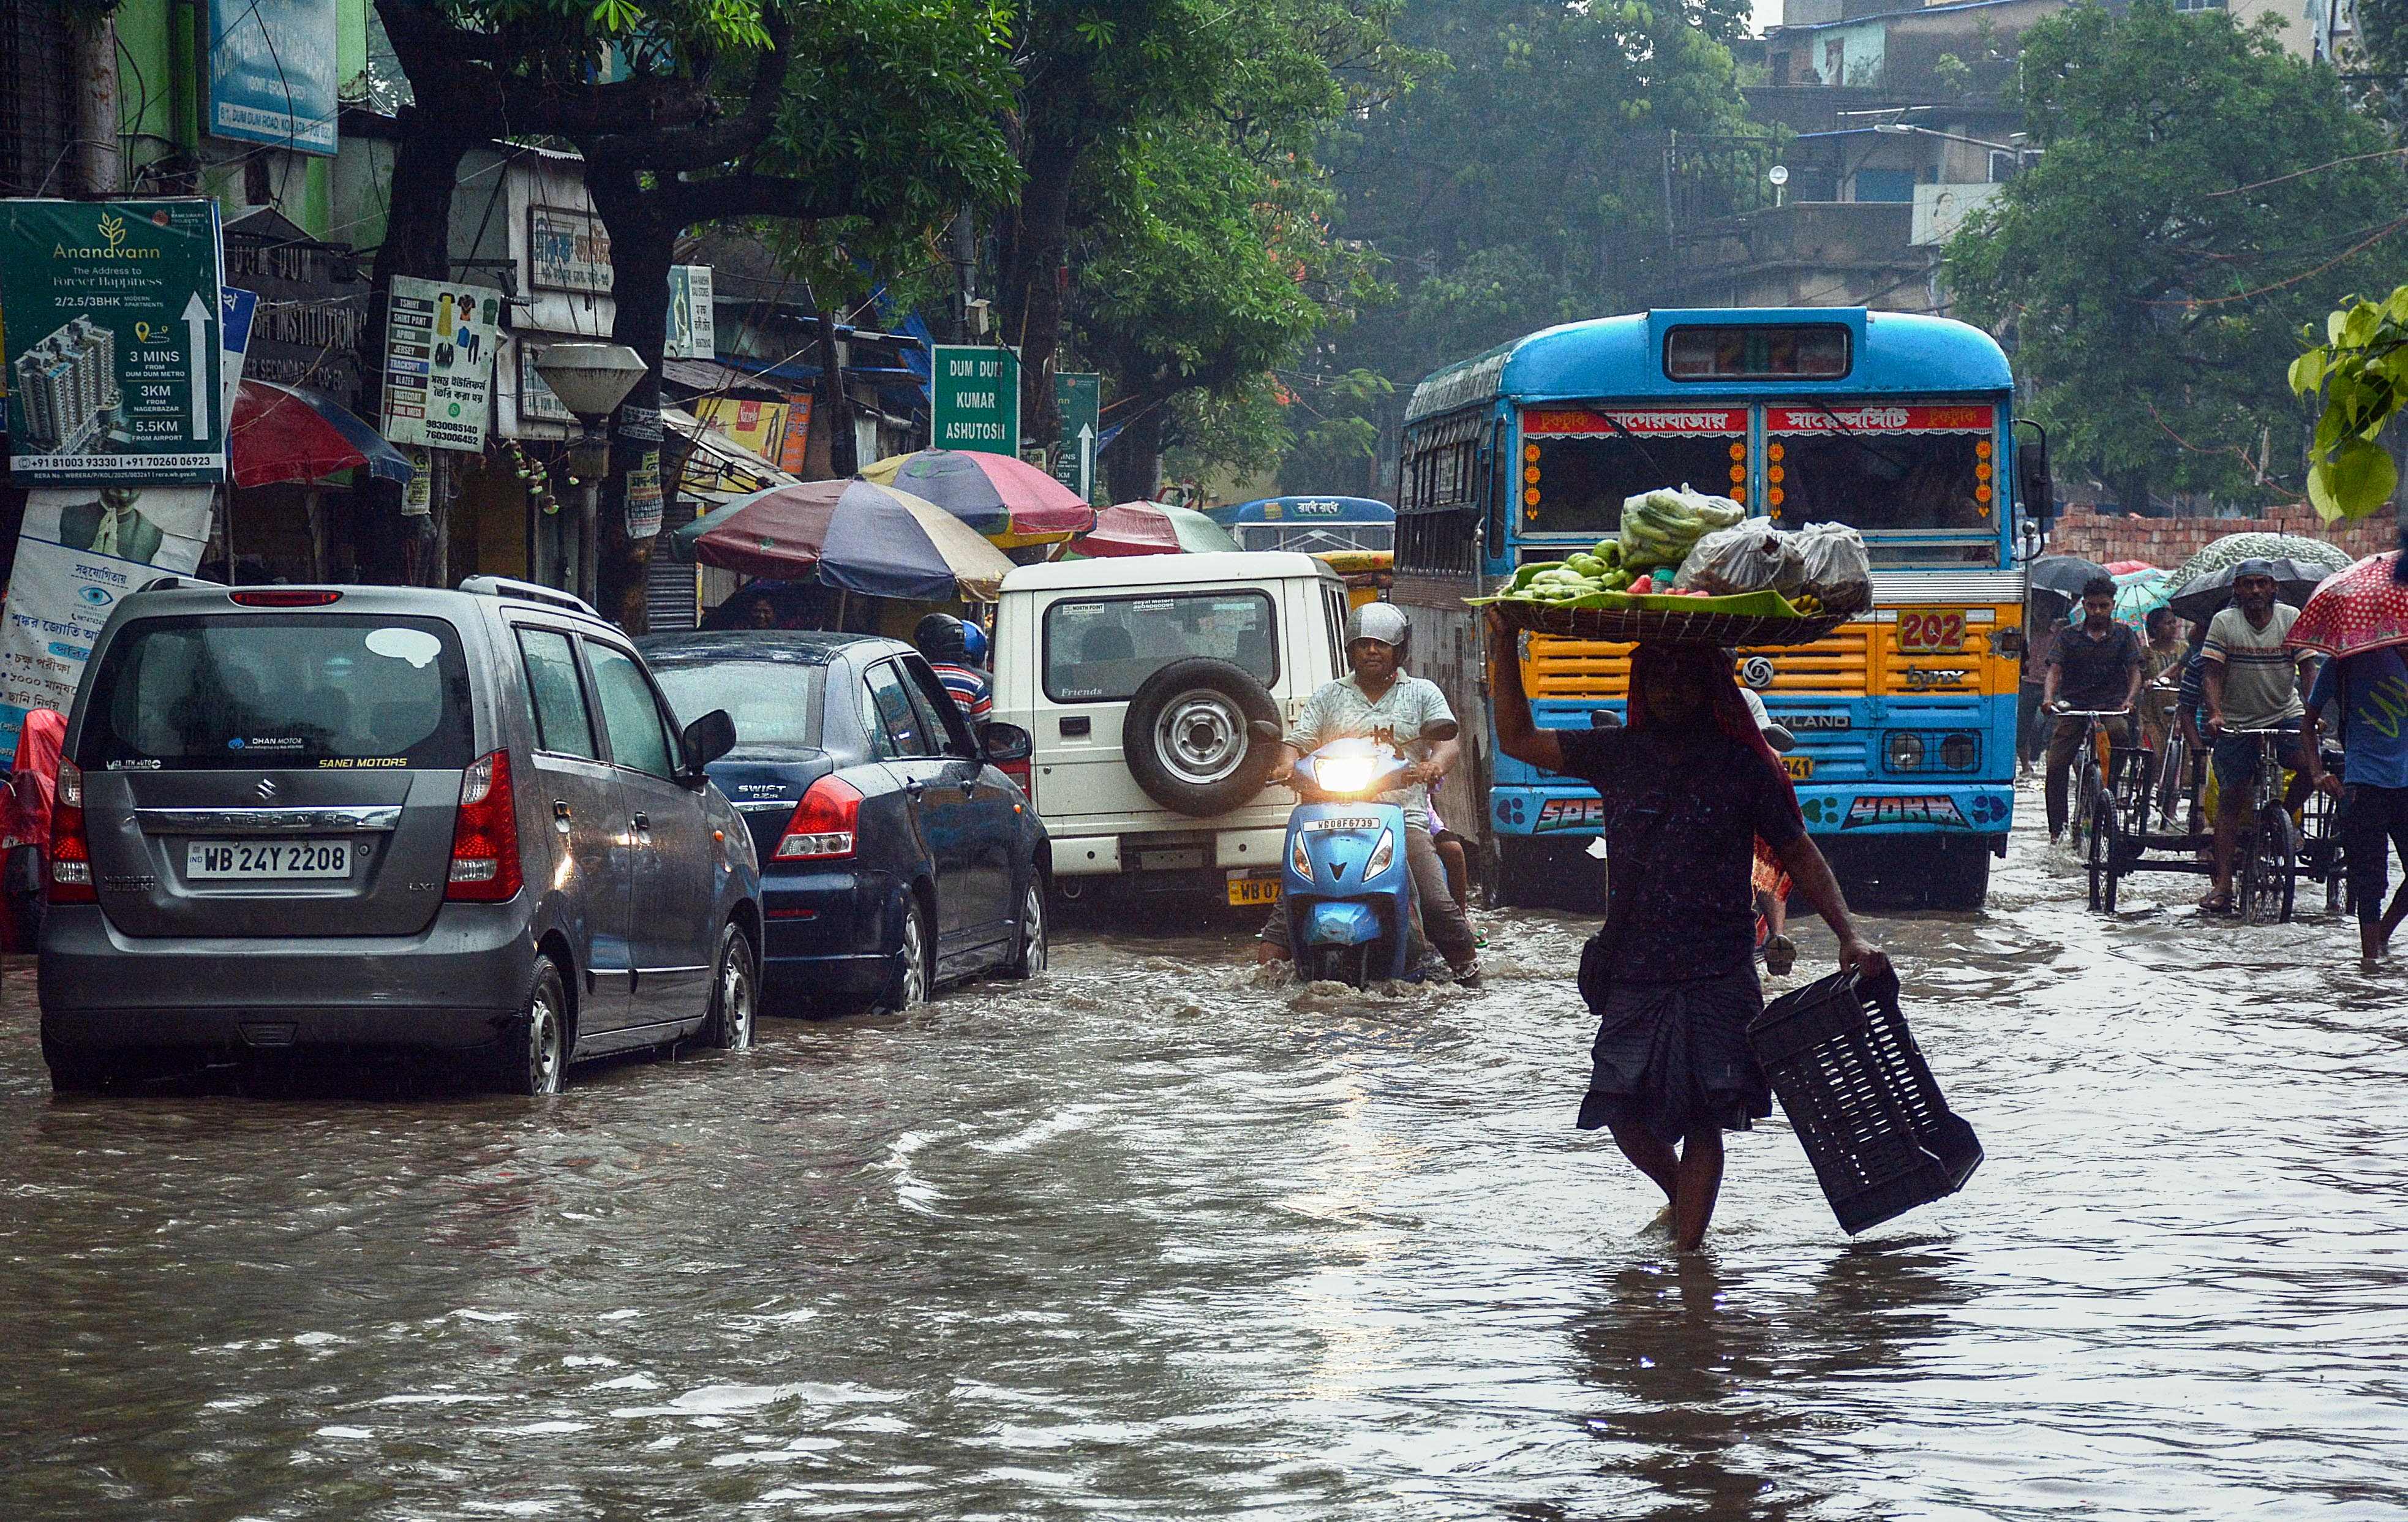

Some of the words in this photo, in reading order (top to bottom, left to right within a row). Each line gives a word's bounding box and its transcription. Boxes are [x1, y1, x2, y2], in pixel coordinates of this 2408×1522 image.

[53, 243, 160, 258] Anandvann
[53, 277, 94, 286] Forever
[99, 277, 162, 288] Happiness
[55, 296, 120, 307] 2/2.5/3BHK
[394, 313, 410, 325] SHIRT
[411, 314, 427, 326] PANT
[396, 329, 416, 341] APRON
[130, 352, 138, 362] 3
[144, 351, 179, 362] MINS
[394, 344, 415, 356] JERSEY
[390, 359, 420, 372] TRACKSUIT
[950, 360, 973, 377] DUM
[396, 375, 414, 386] BLAZER
[431, 375, 450, 386] সমস্ত
[451, 376, 487, 391] ইউনিফর্ম
[141, 385, 170, 396] 3KM
[394, 390, 421, 402] AISTCOAT
[434, 386, 451, 398] তৈরি
[453, 392, 470, 401] করা
[472, 394, 483, 404] হয়
[957, 392, 995, 409] KUMAR
[388, 404, 407, 415] SHOOL
[407, 405, 421, 417] DRESS
[136, 421, 178, 432] 5.5KM
[426, 420, 478, 434] 9830085140
[946, 422, 1005, 440] ASHUTOSH
[426, 430, 478, 445] 7603006452
[126, 458, 143, 467] +91
[147, 458, 177, 466] 70260
[180, 457, 211, 465] 06923
[42, 620, 81, 637] জ্যোতি
[1903, 614, 1960, 647] 202
[36, 657, 70, 674] পরীক্ষা
[10, 672, 40, 686] ১০০০
[1061, 688, 1102, 696] Friends
[8, 691, 29, 704] ছানি
[34, 694, 59, 710] নির্ণয়
[357, 758, 407, 767] MOTORS
[205, 848, 232, 872] WB
[240, 848, 282, 872] 24Y
[288, 847, 344, 871] 2208
[1241, 884, 1260, 900] WB
